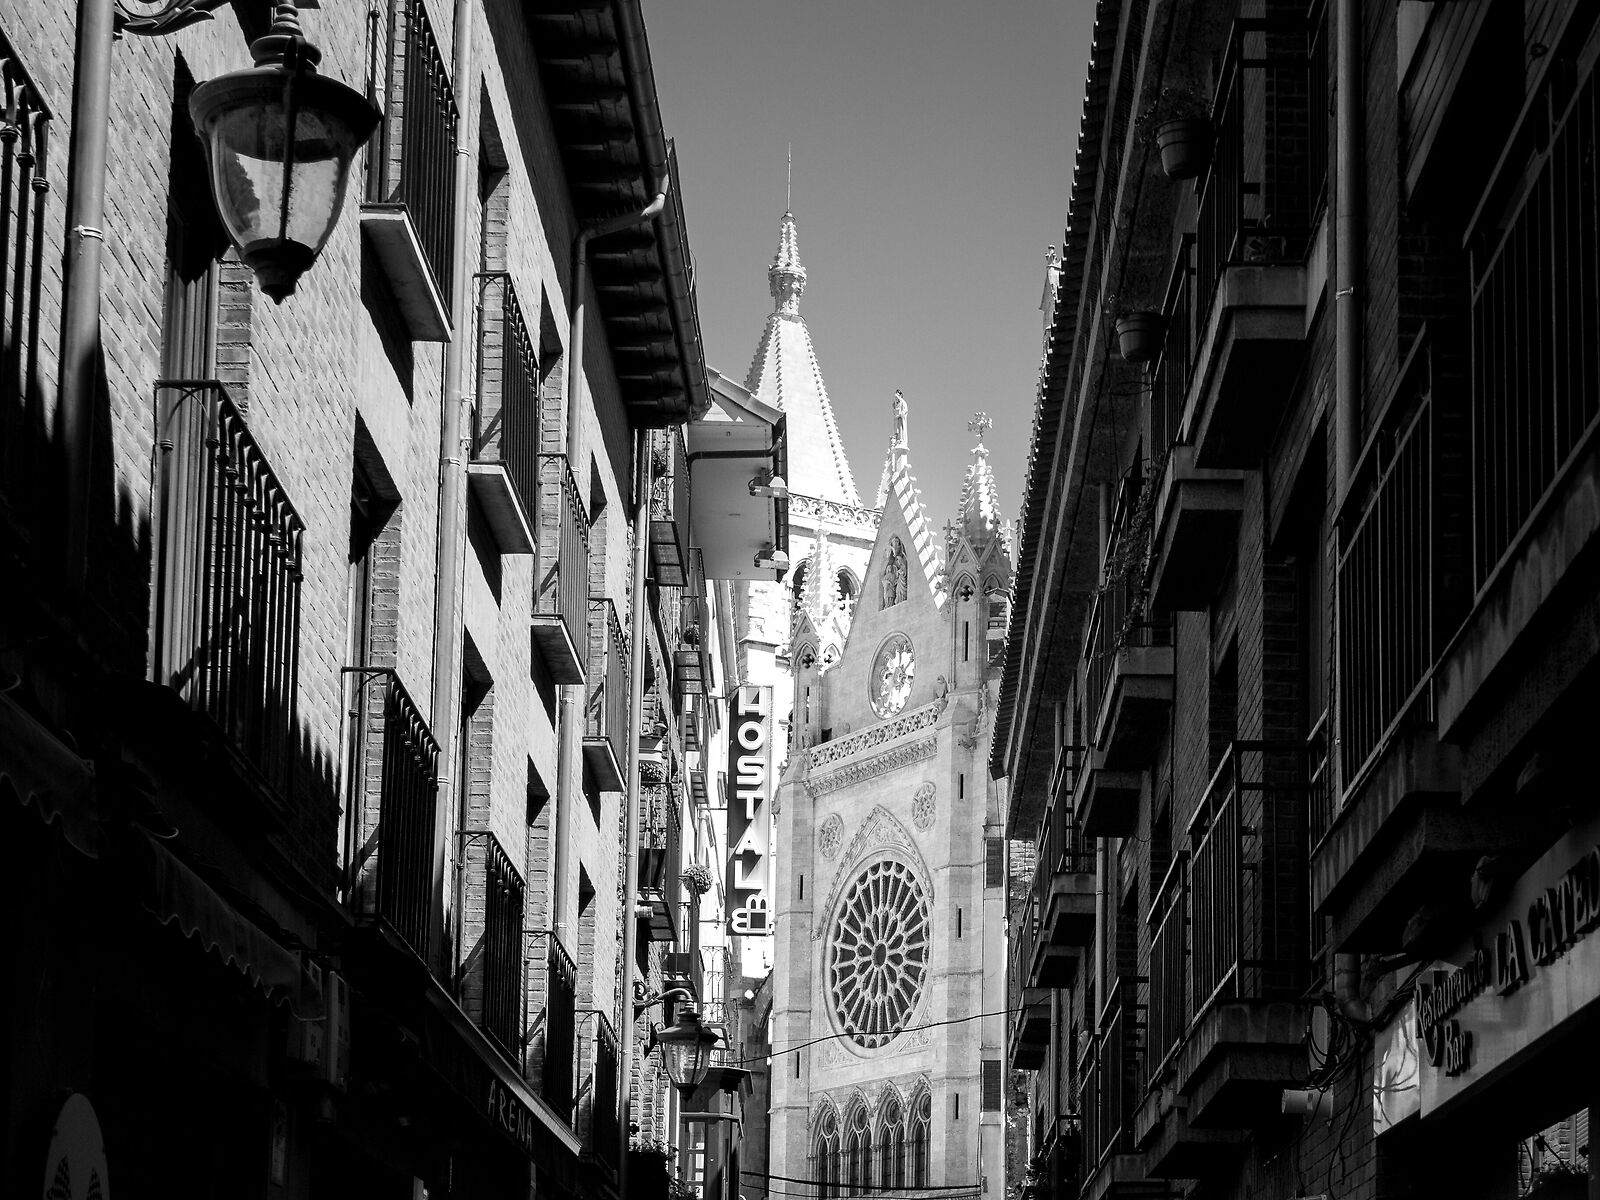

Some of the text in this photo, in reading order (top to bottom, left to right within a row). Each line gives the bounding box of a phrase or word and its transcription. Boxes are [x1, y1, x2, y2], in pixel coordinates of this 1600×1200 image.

[734, 685, 767, 891] HOSTAL
[1495, 919, 1530, 997] LA
[1445, 1019, 1473, 1078] Bar
[487, 1079, 533, 1153] ARENA
